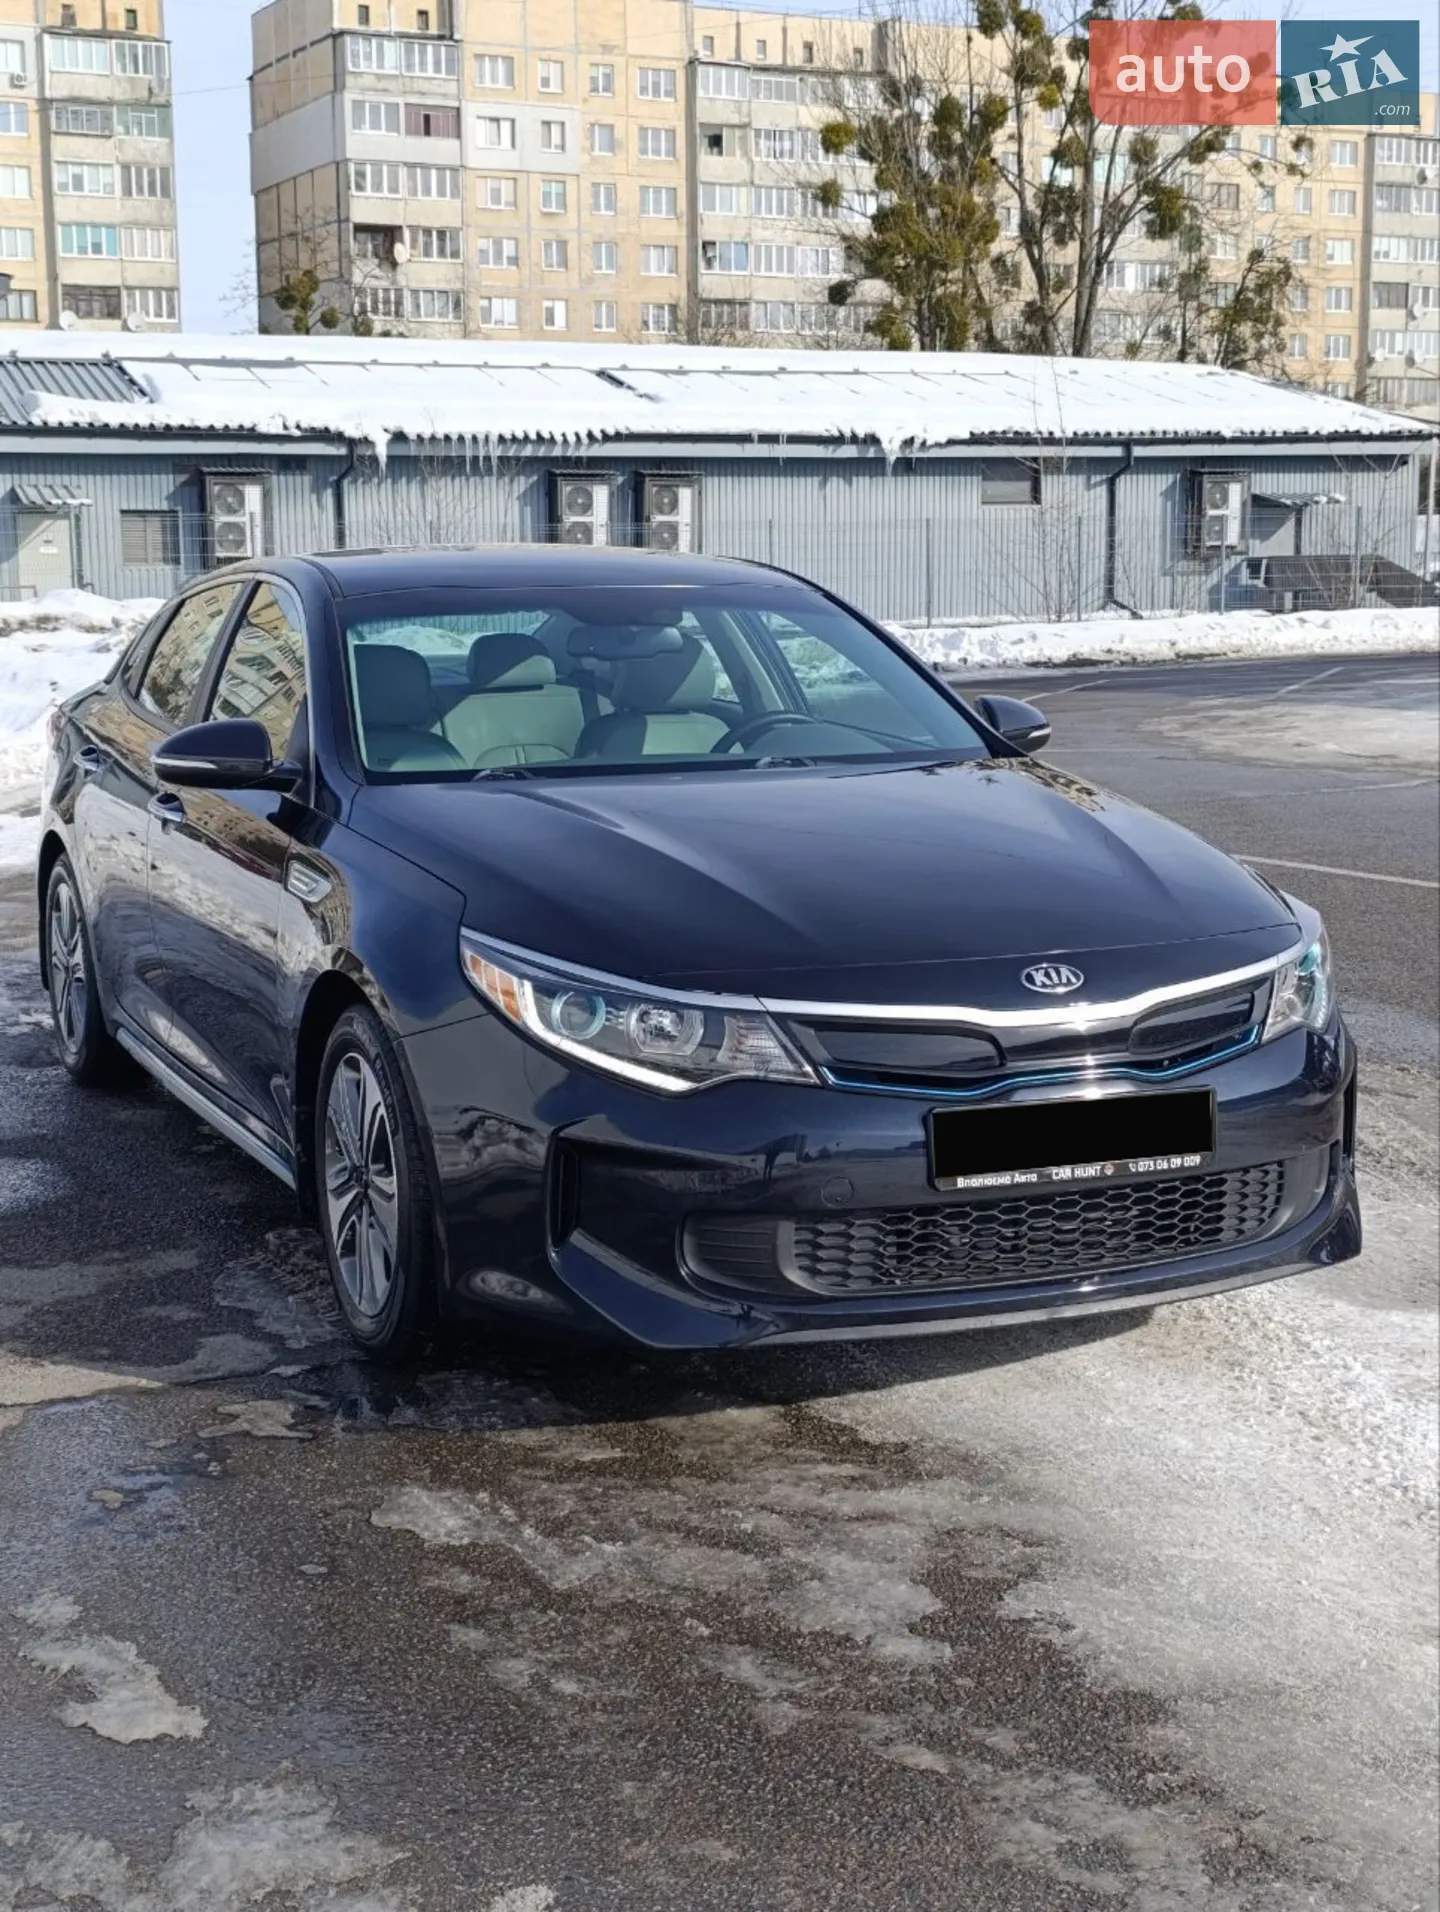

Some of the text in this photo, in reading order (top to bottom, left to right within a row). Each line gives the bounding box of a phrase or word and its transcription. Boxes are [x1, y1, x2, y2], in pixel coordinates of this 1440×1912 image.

[1030, 967, 1077, 987] KIA
[1052, 1165, 1101, 1180] CAR HUNT
[1138, 1161, 1154, 1172] 073
